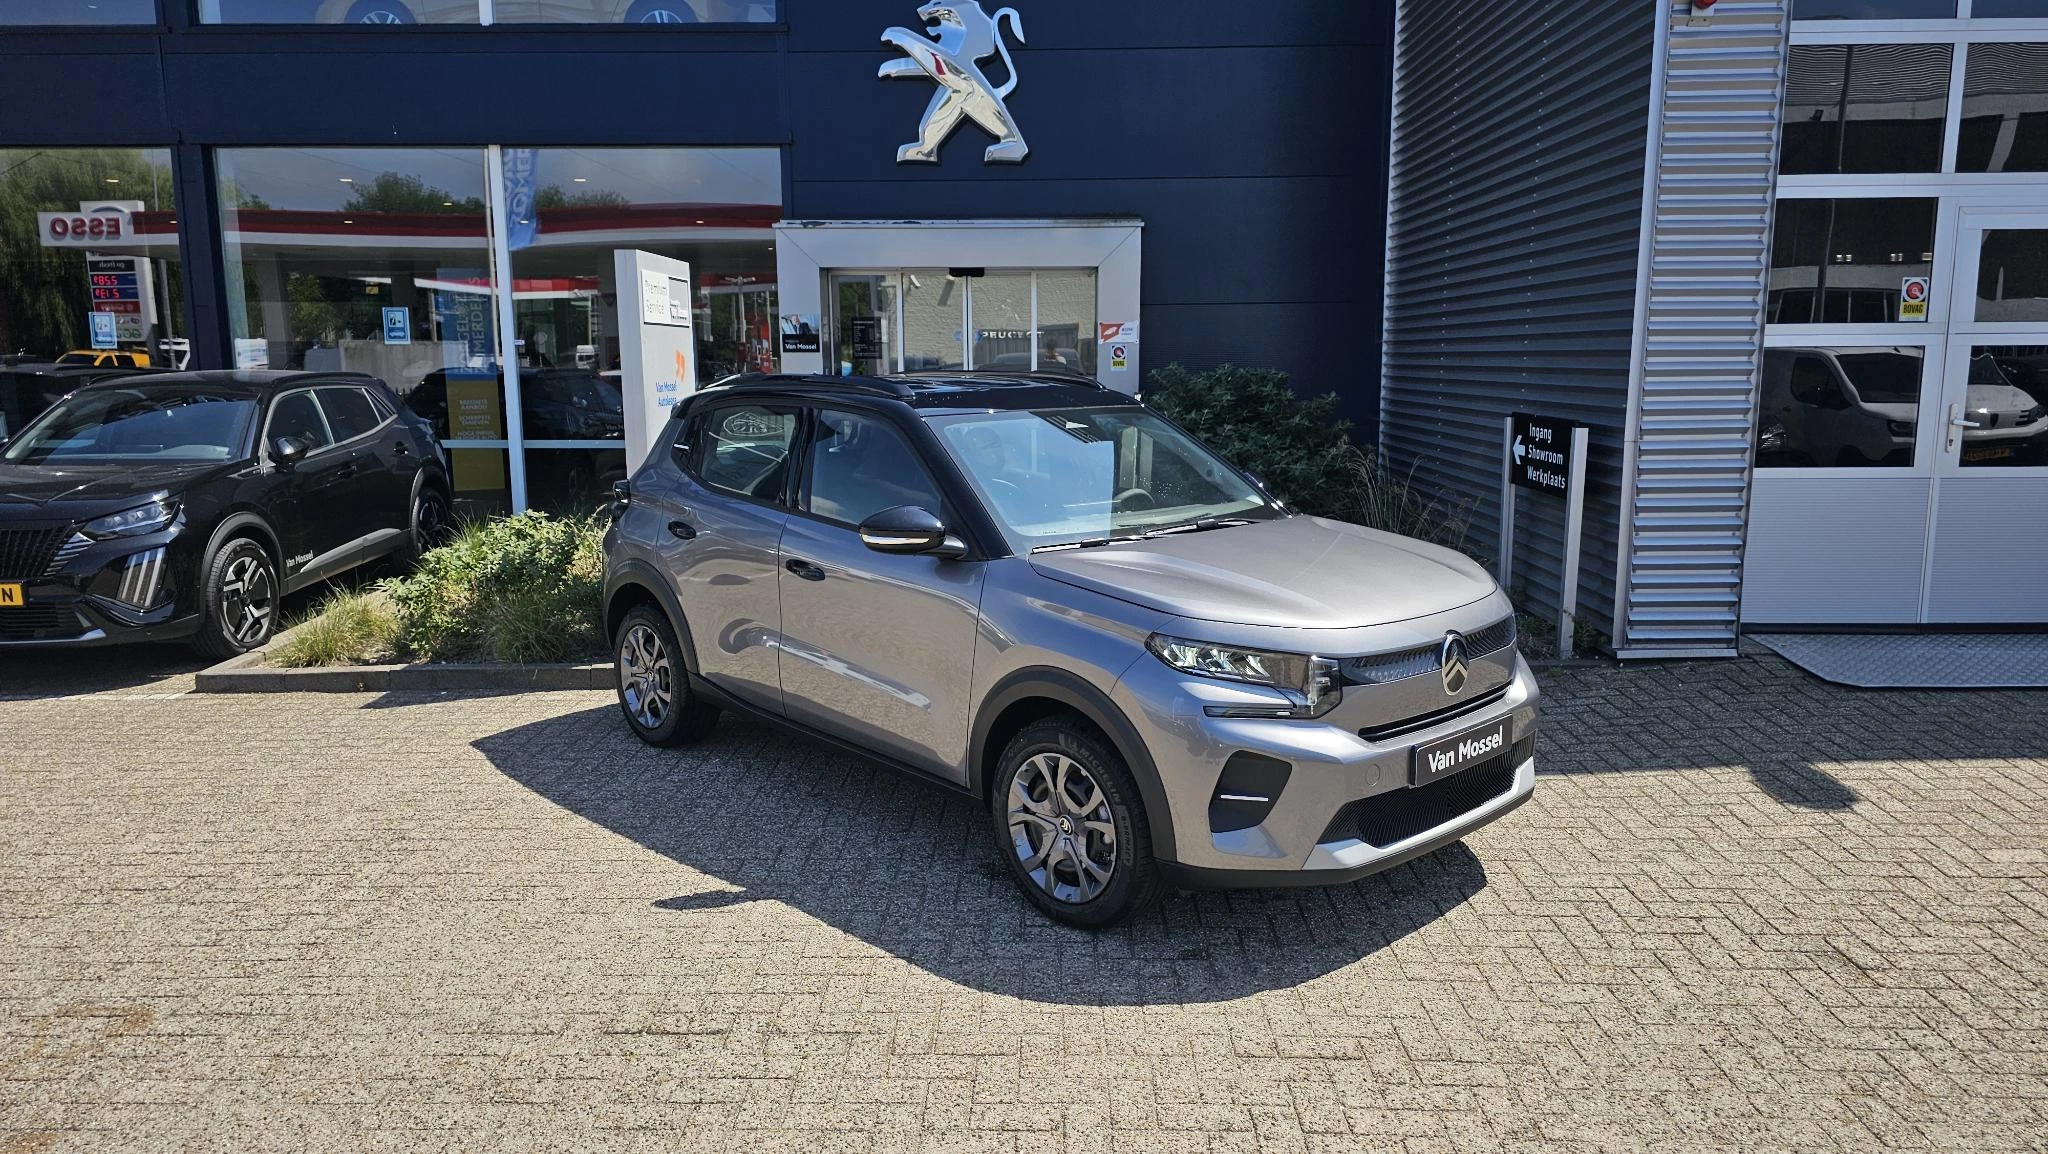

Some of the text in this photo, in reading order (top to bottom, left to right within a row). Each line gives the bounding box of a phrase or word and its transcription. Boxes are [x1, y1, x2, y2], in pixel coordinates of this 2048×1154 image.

[1903, 304, 1924, 314] BOVAG
[656, 380, 677, 393] Van Mossel
[1529, 423, 1552, 443] Ingang
[1528, 444, 1563, 465] Showroom
[1527, 465, 1566, 489] Werkplaats
[285, 549, 314, 568] Van Mossel
[1, 587, 14, 602] N
[1428, 725, 1503, 773] Van Mossel
[1079, 748, 1122, 804] MICHELIN
